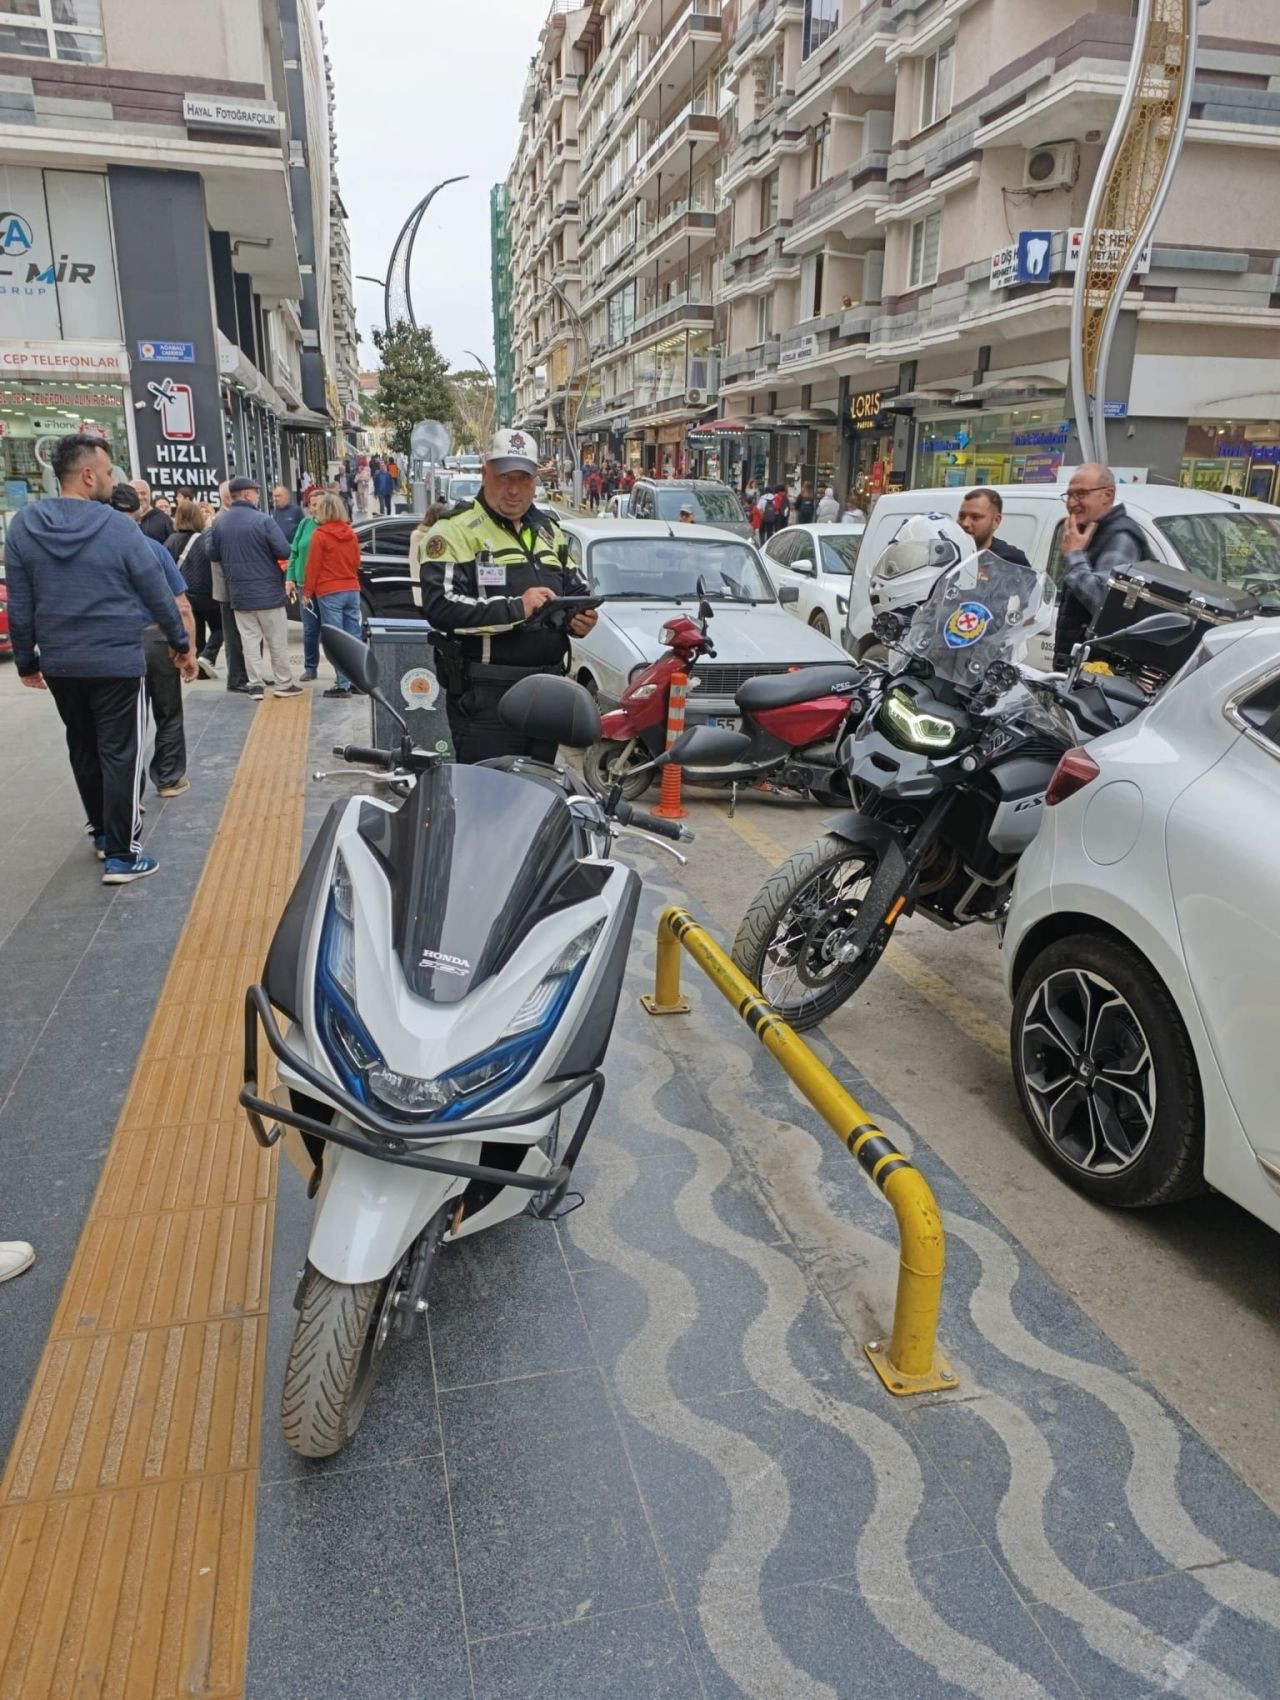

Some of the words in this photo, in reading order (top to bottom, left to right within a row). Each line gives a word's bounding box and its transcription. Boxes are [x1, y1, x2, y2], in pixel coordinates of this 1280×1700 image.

[187, 103, 212, 117] HAYAL
[216, 107, 275, 124] FOTOĞRAFÇILIK
[3, 354, 28, 365] CEP
[31, 355, 119, 368] TELEFONLARI
[850, 392, 880, 418] LORIS
[156, 444, 207, 463] HIZLI
[147, 467, 219, 486] TEKNİK
[422, 948, 470, 968] HONDA
